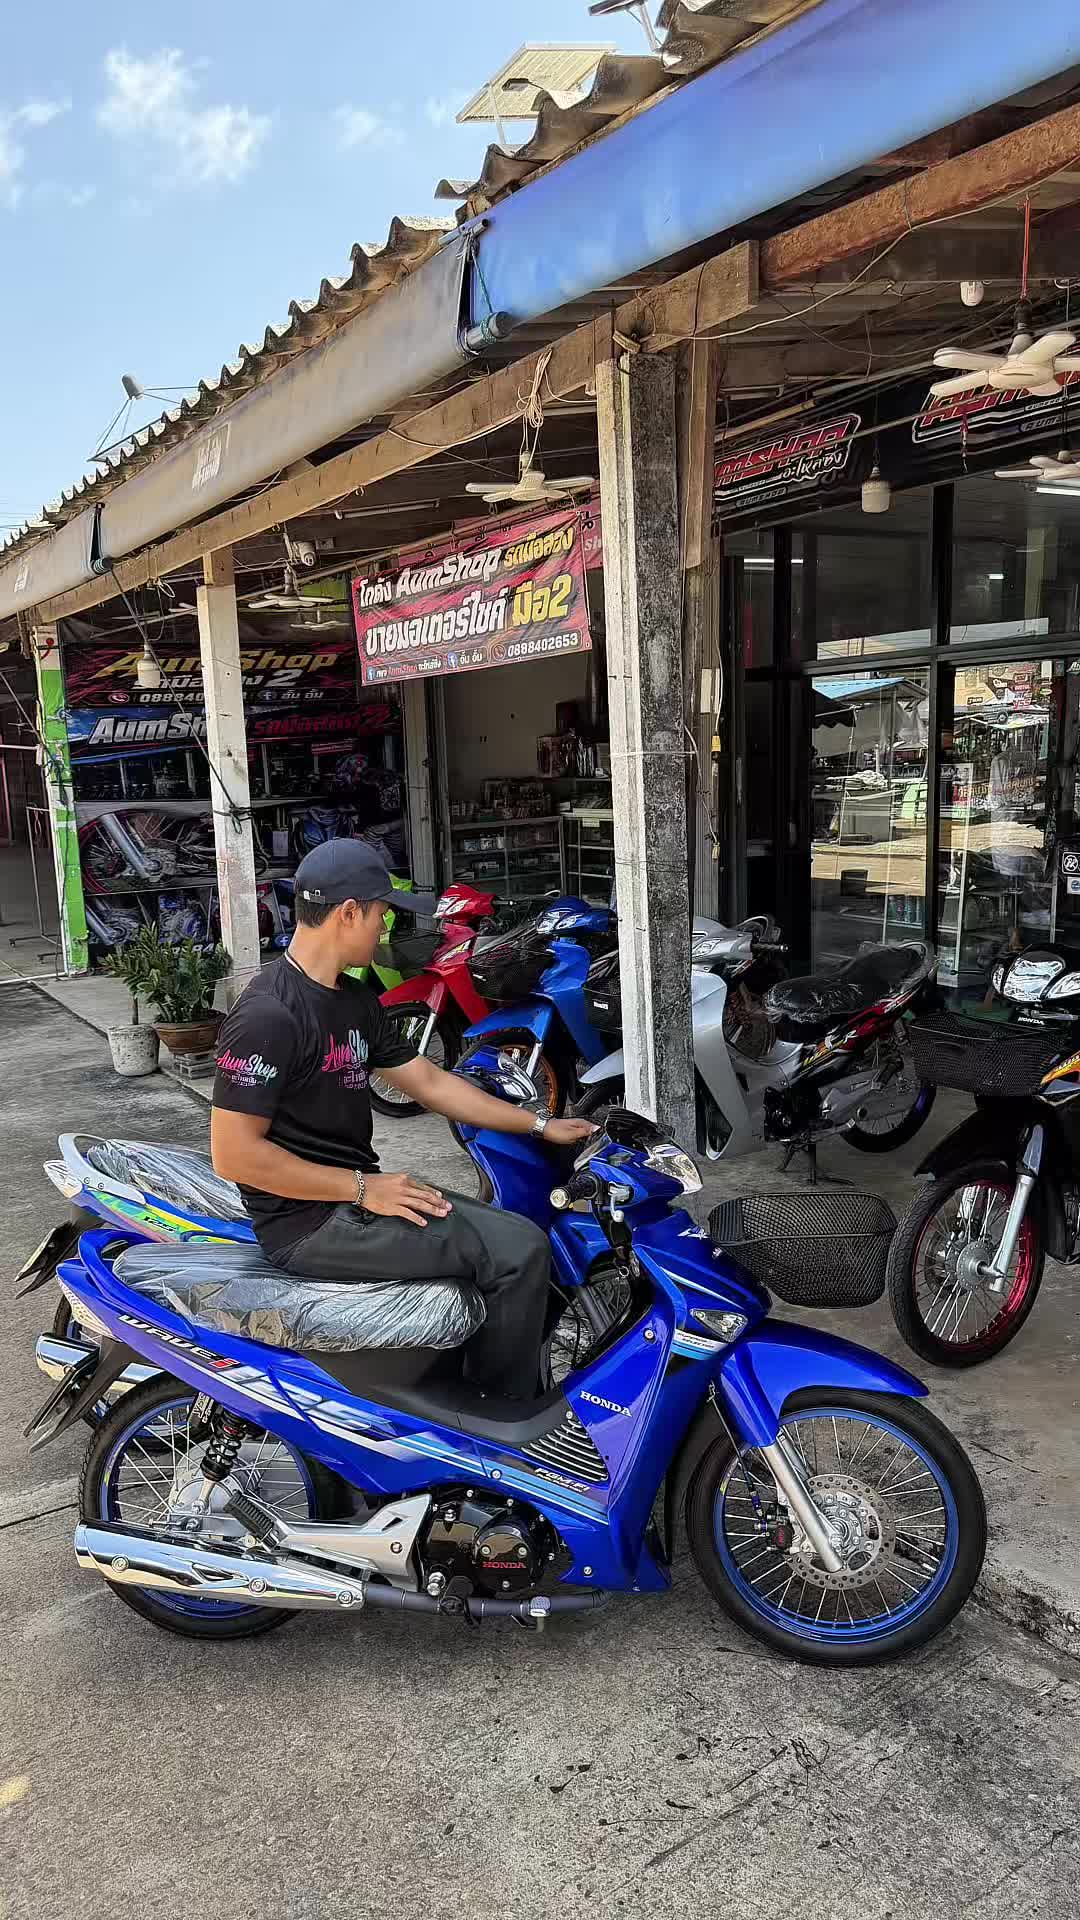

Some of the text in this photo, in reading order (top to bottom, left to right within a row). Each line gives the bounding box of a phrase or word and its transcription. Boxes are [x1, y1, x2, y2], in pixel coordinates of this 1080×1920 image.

[360, 526, 575, 608] โกดัง AumShop รถมือสอง
[507, 632, 579, 656] 0888402653
[264, 669, 304, 688] 2
[216, 1048, 279, 1083] AumShop
[579, 1390, 633, 1418] HONDA
[482, 1561, 527, 1569] HONDA
